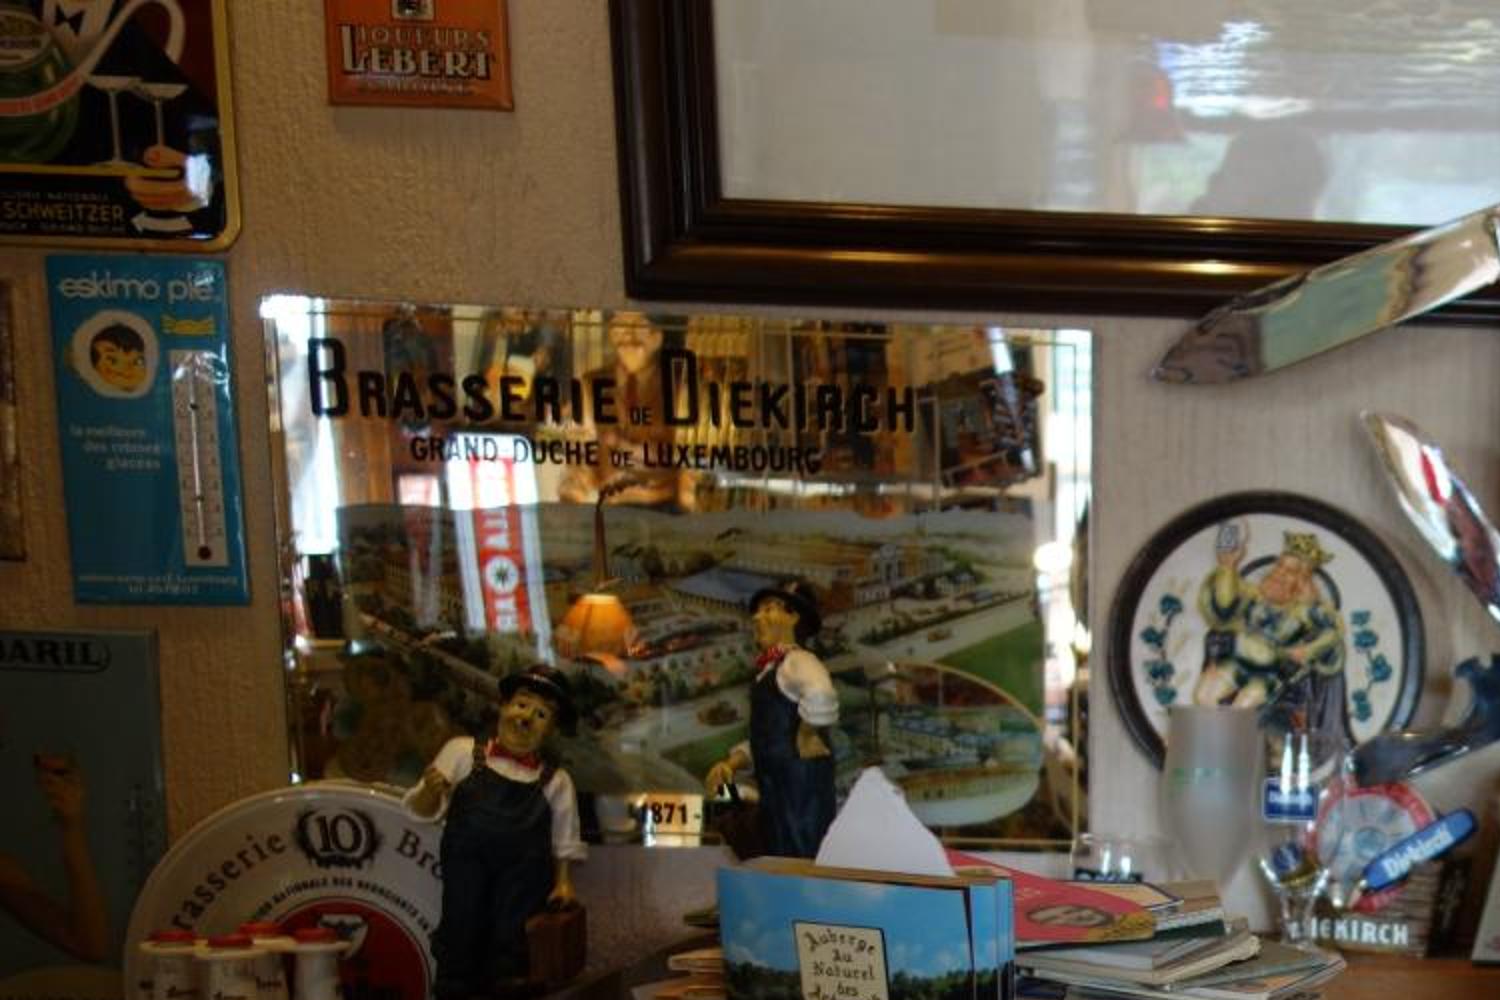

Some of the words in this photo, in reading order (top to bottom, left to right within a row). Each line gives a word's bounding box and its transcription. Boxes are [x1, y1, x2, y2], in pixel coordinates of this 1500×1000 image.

[341, 25, 494, 80] LEBERT
[60, 271, 160, 300] eskimo
[307, 336, 618, 426] BRASSERIE
[629, 407, 653, 426] DE
[662, 348, 916, 434] DIEKIRCH
[410, 436, 498, 464] GRAND
[512, 438, 598, 467] DUCHE
[610, 451, 634, 467] DE
[643, 442, 824, 477] LUXEMBOURG
[0, 640, 101, 665] ARIL
[316, 813, 364, 853] 10
[173, 832, 286, 934] rasserie
